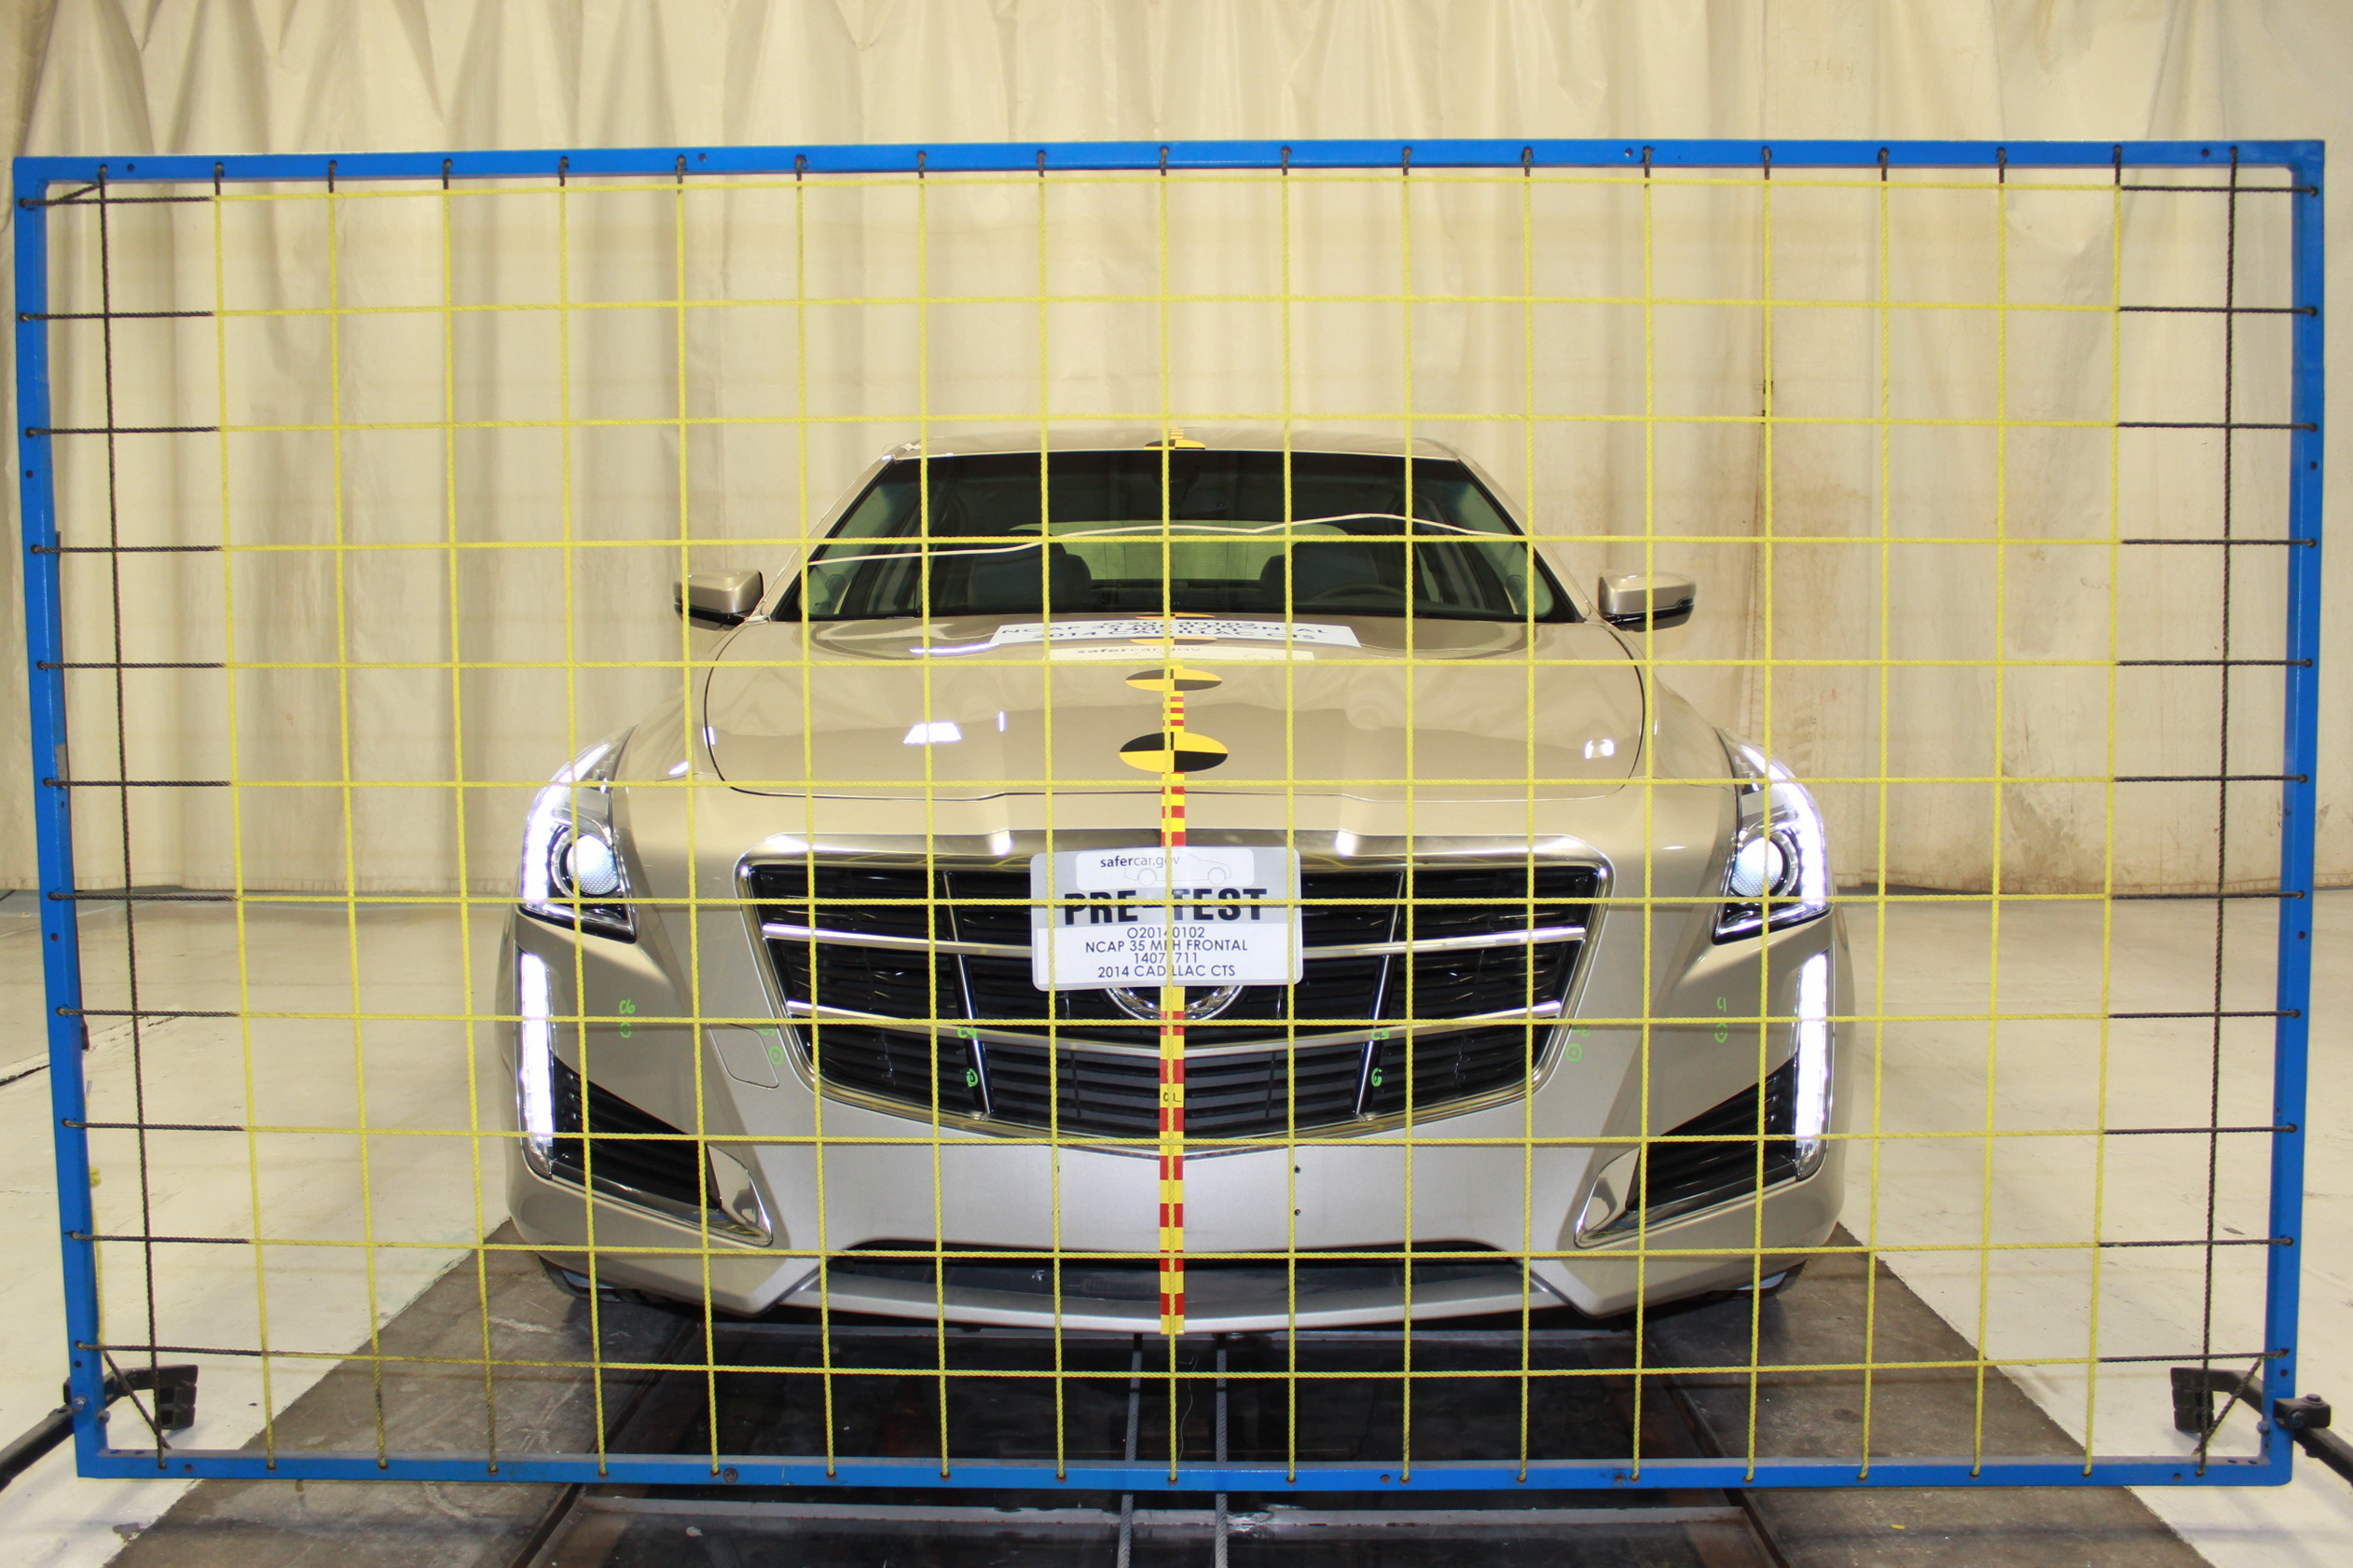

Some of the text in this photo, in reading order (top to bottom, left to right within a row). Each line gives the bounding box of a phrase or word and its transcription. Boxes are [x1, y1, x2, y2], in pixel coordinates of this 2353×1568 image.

[1206, 624, 1328, 633] FRONAL
[1100, 855, 1180, 869] safercar.gv
[1085, 941, 1125, 953] NCAP
[1129, 940, 1145, 952] 35
[1187, 939, 1248, 951] FRONTAL
[1134, 952, 1197, 964] 1407711
[1097, 964, 1236, 978] 2014 CADLLAC CTS
